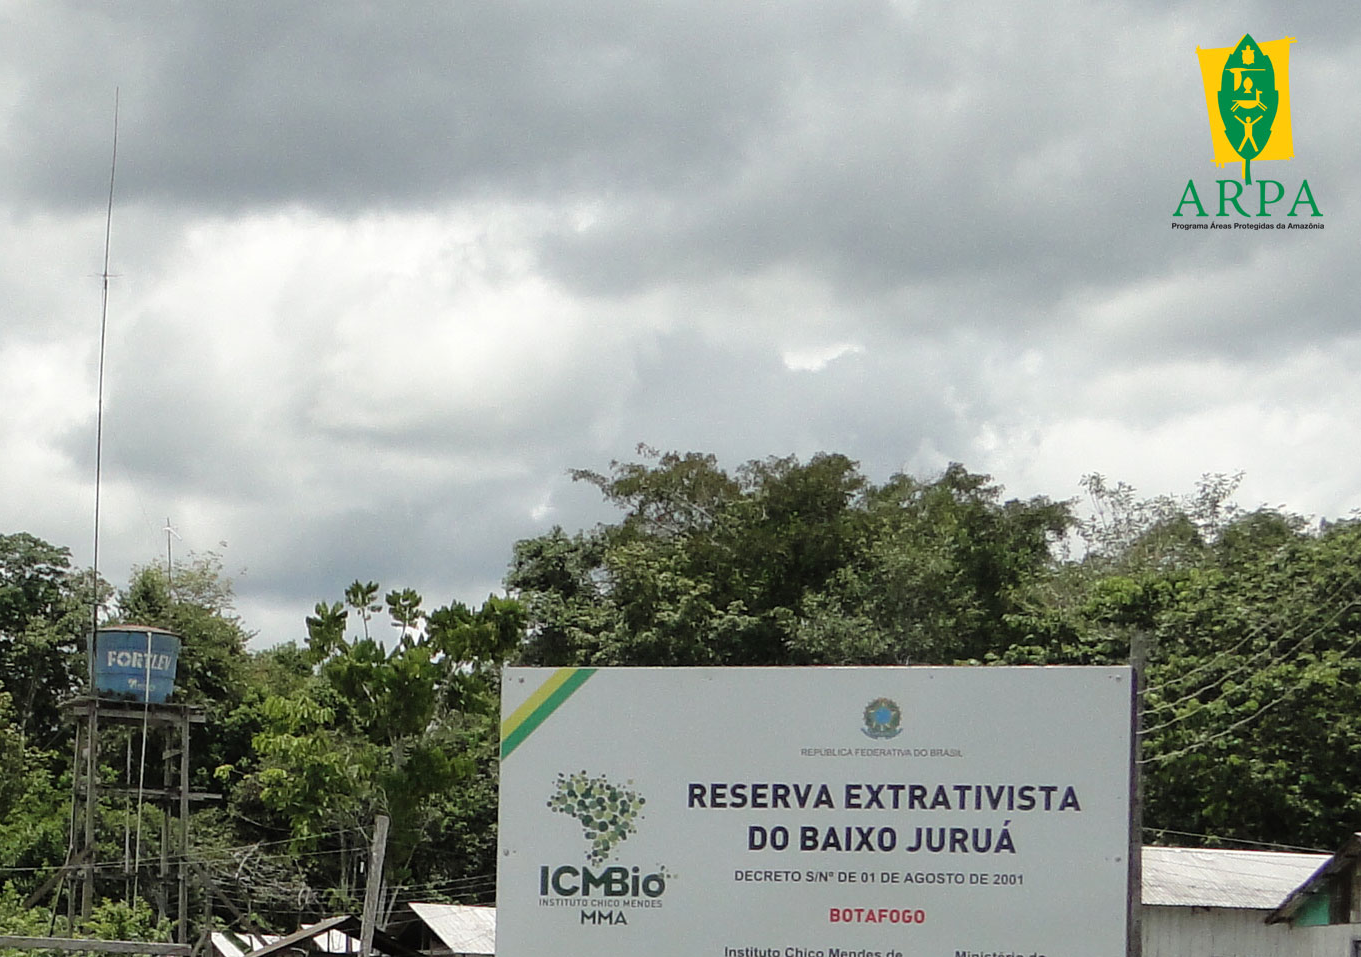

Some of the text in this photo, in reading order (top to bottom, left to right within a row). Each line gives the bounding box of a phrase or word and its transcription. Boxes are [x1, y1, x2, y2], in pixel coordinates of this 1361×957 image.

[107, 650, 172, 671] FORTLEV
[854, 748, 912, 757] FEDERATIVA
[913, 748, 928, 757] DO
[930, 749, 963, 758] BRASIL
[688, 783, 1081, 812] RESERVA EXTRATIVISTA
[748, 820, 1017, 854] DO BAIXO JURUÁ
[540, 866, 665, 897] ICMBio
[734, 870, 802, 882] DECRETO
[837, 871, 857, 883] DE
[861, 872, 875, 883] 01
[880, 872, 900, 884] DE
[904, 872, 965, 885] AGOSTO
[969, 873, 989, 885] DE
[993, 873, 1024, 885] 2001
[539, 898, 662, 908] INSTITUTO CHICO MENDES
[581, 909, 627, 925] MMA
[829, 908, 926, 924] BOTAFOGO
